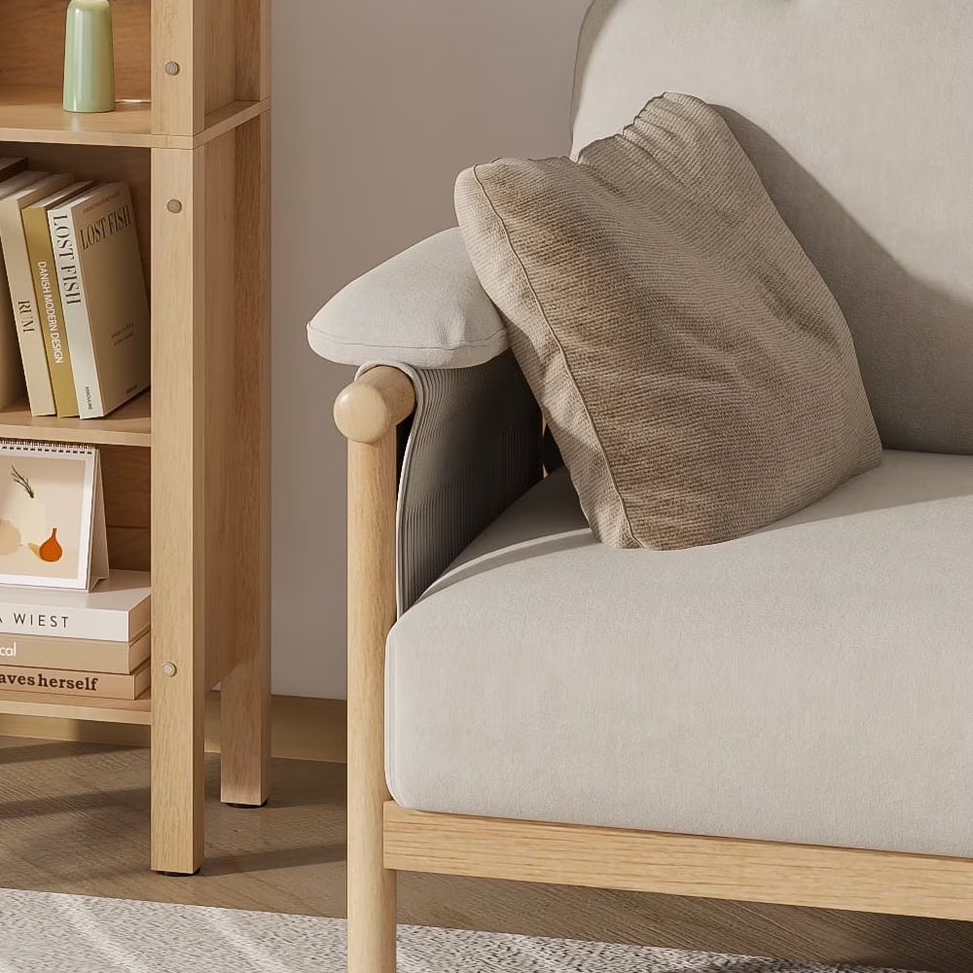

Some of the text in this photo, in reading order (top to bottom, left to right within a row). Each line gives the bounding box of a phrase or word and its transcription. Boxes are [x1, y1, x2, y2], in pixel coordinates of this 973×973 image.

[80, 205, 131, 250] LOST FISH
[53, 214, 81, 304] LOST FISH
[18, 300, 36, 333] RUM
[37, 261, 64, 364] DANISH MODERN DESIGN
[13, 612, 70, 628] WIEST
[38, 673, 99, 691] herself
